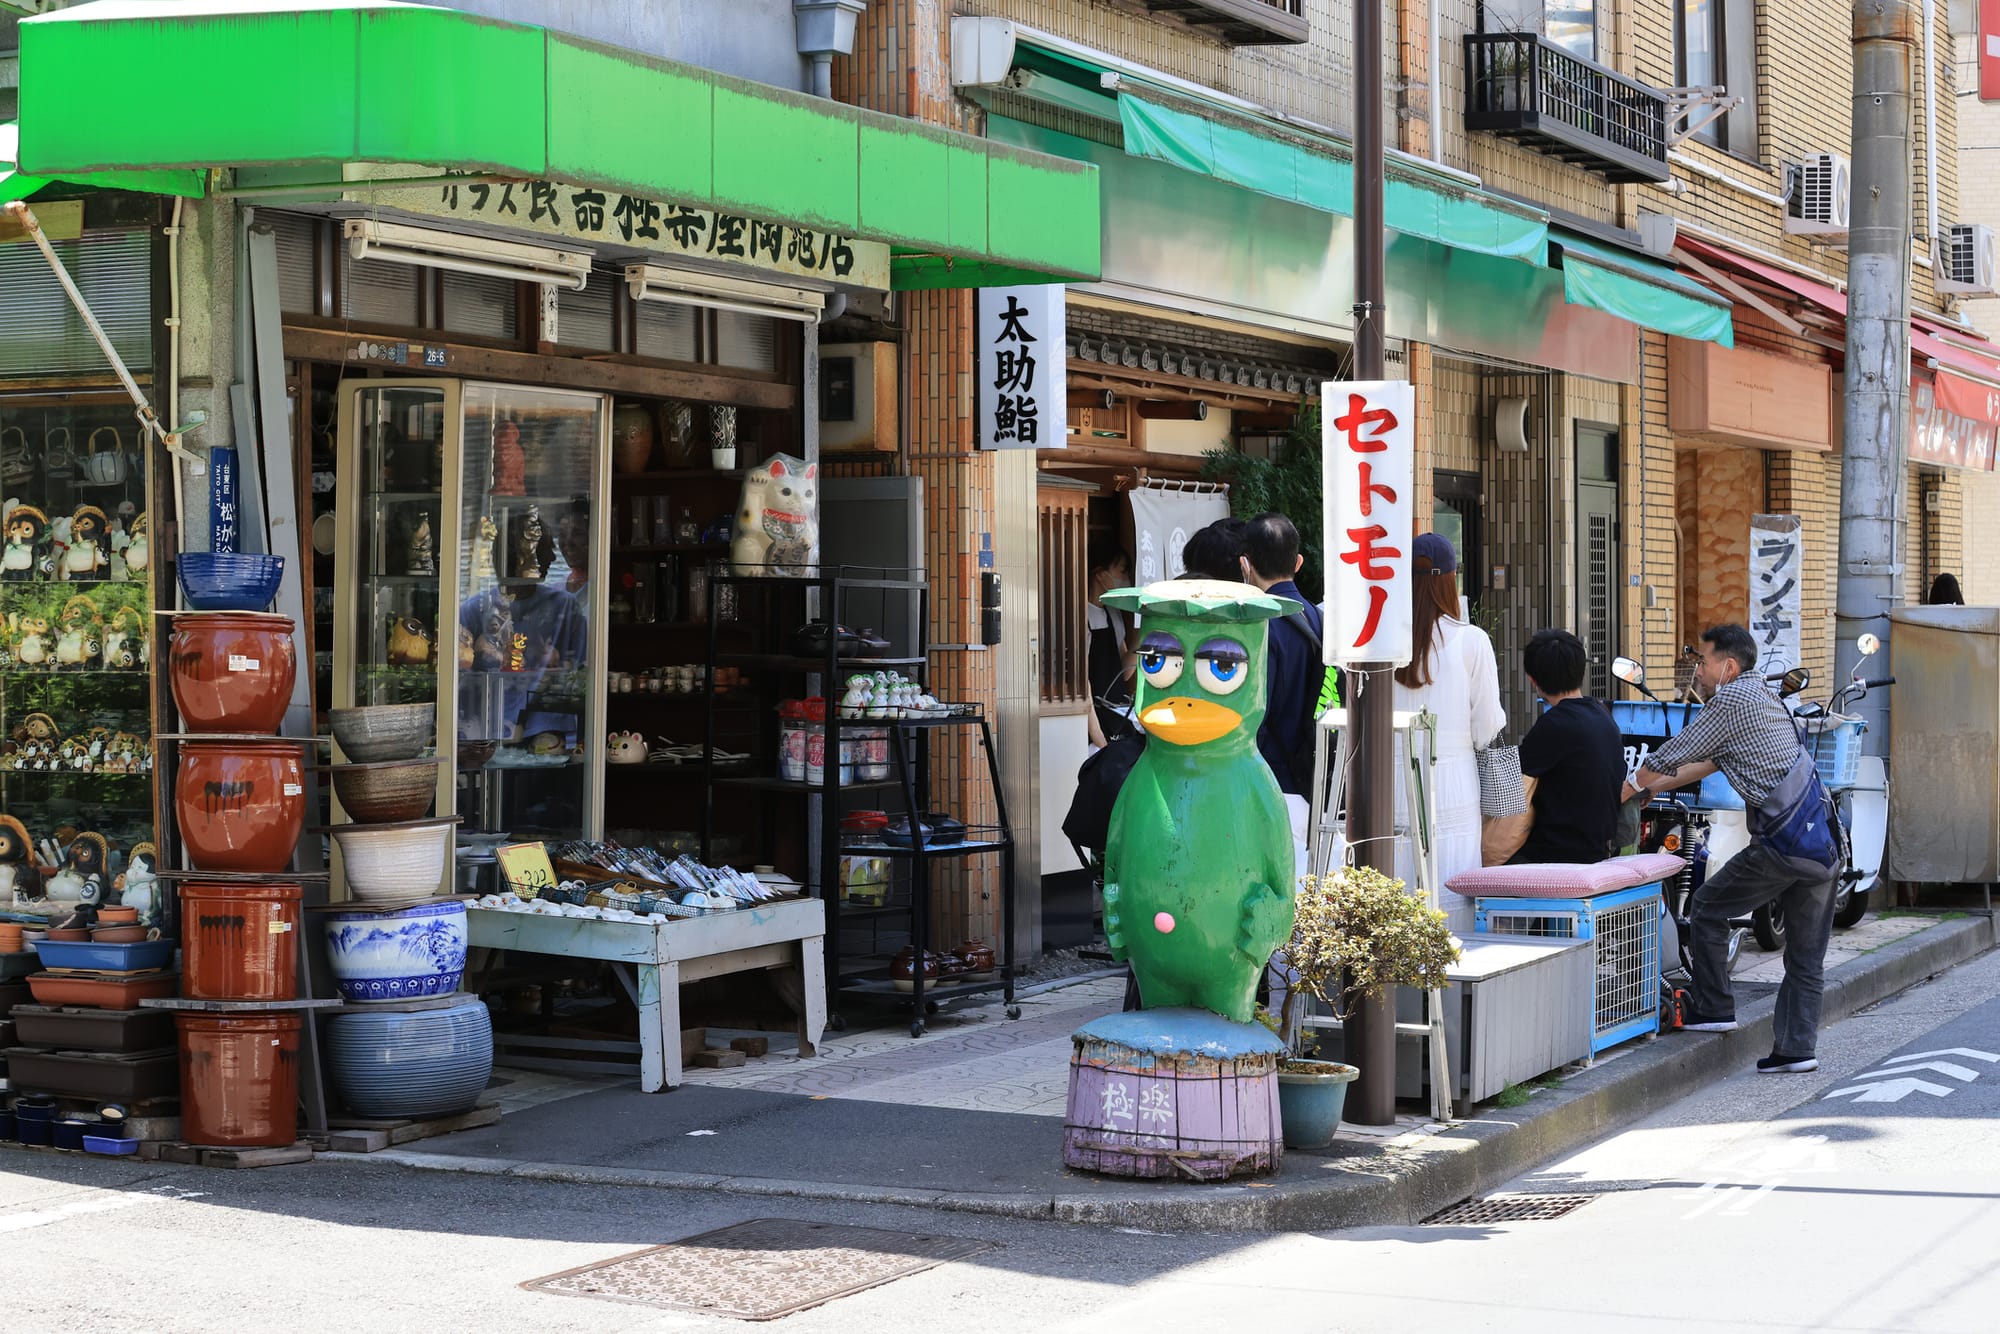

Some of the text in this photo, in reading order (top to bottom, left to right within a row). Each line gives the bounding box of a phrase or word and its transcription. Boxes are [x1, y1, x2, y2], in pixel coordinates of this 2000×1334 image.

[427, 350, 445, 363] 26-6
[993, 295, 1038, 445] 太助鮨
[223, 464, 231, 495] 台東区
[1333, 392, 1402, 648] セトモノ
[1140, 529, 1156, 586] 太助
[1753, 537, 1796, 646] ランチ
[1101, 1082, 1174, 1124] 極楽
